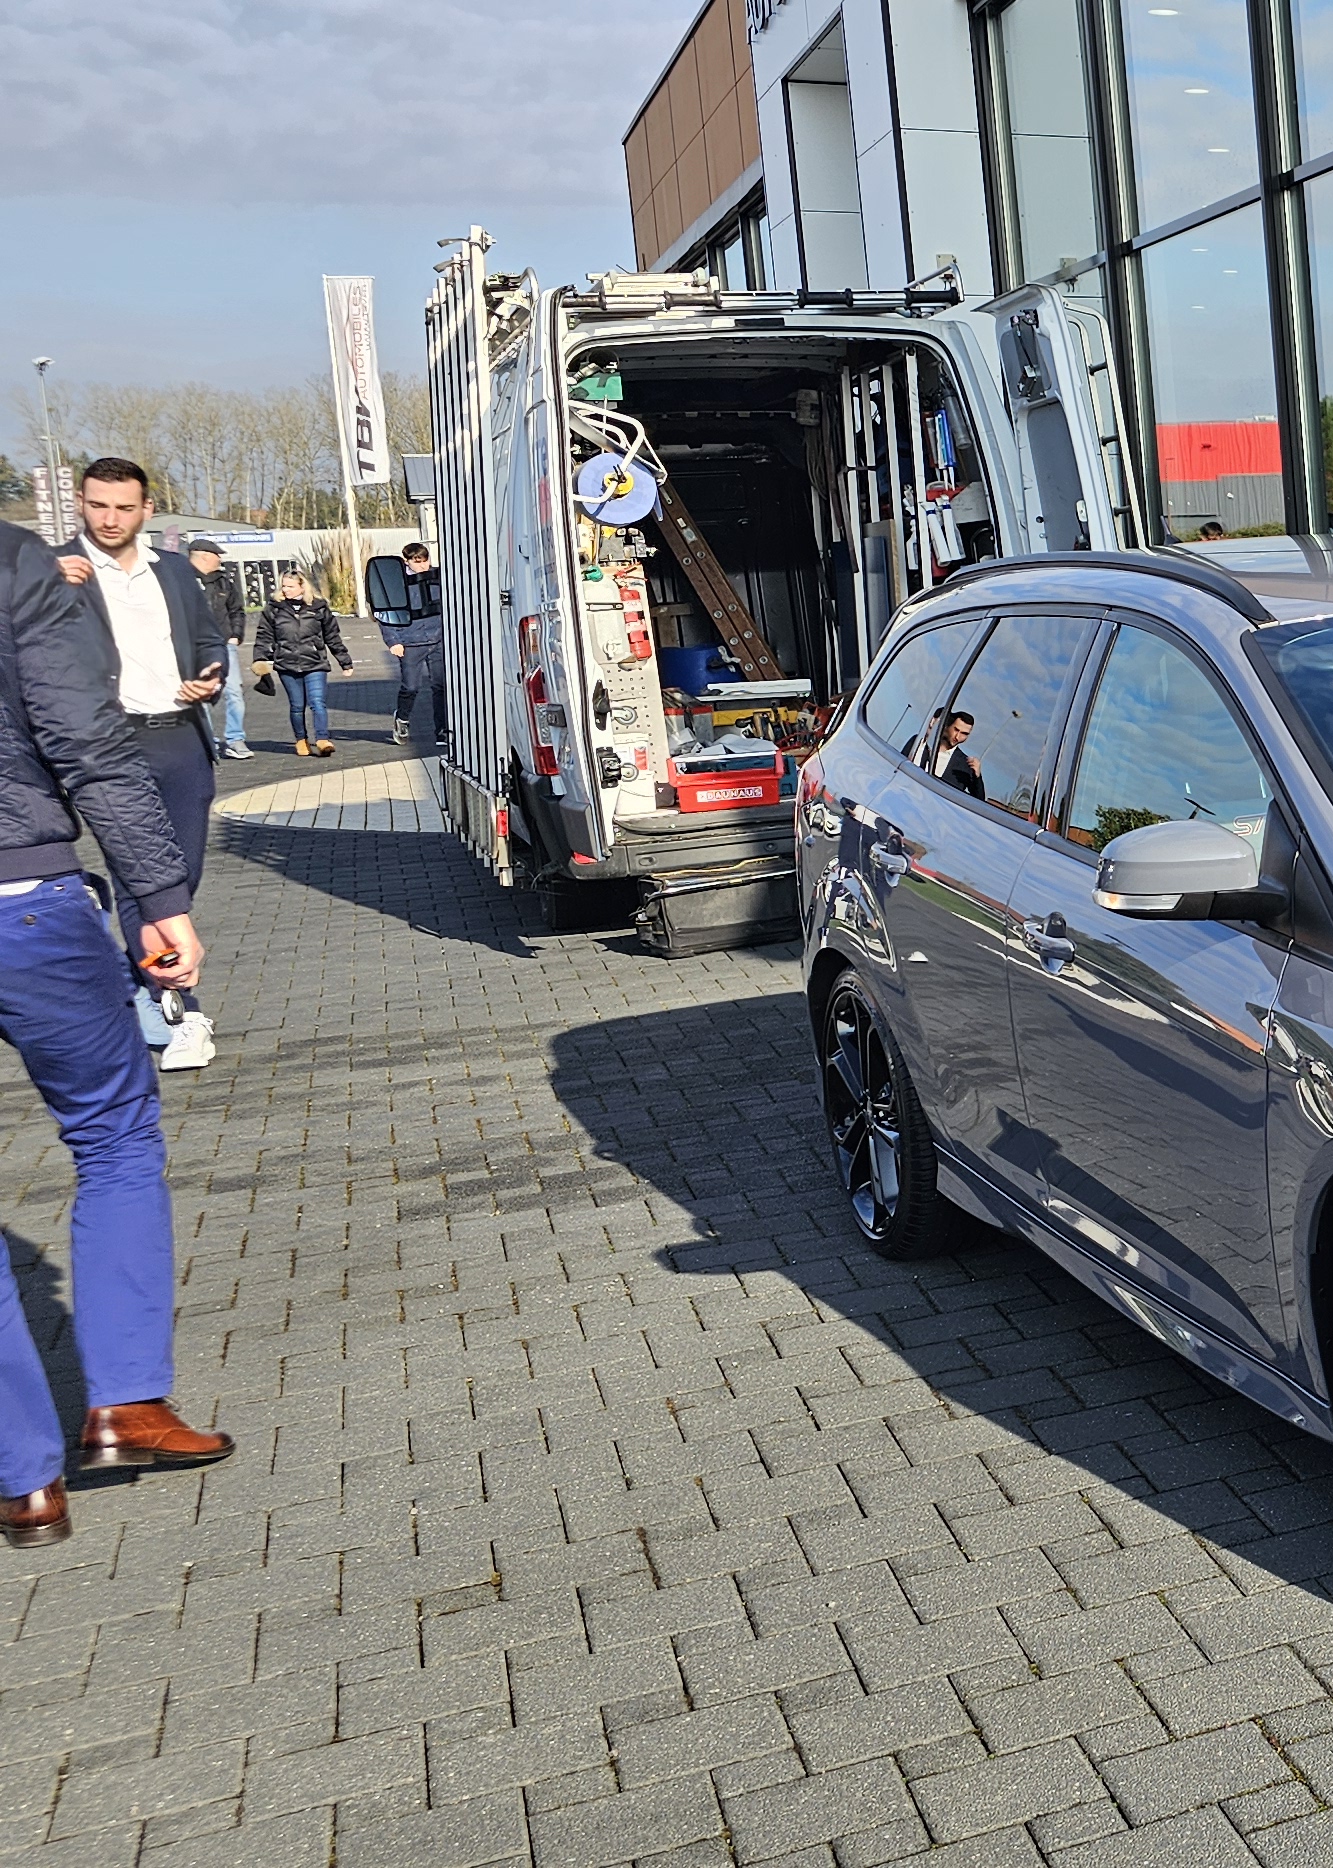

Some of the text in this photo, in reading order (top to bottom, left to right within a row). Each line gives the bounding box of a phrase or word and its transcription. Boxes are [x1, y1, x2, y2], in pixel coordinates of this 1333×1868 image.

[352, 285, 368, 400] AUTOMOBILES
[355, 385, 376, 480] TBV
[33, 467, 56, 546] FITNESS
[56, 467, 77, 540] CONCEP
[706, 786, 762, 801] BAUHAUS
